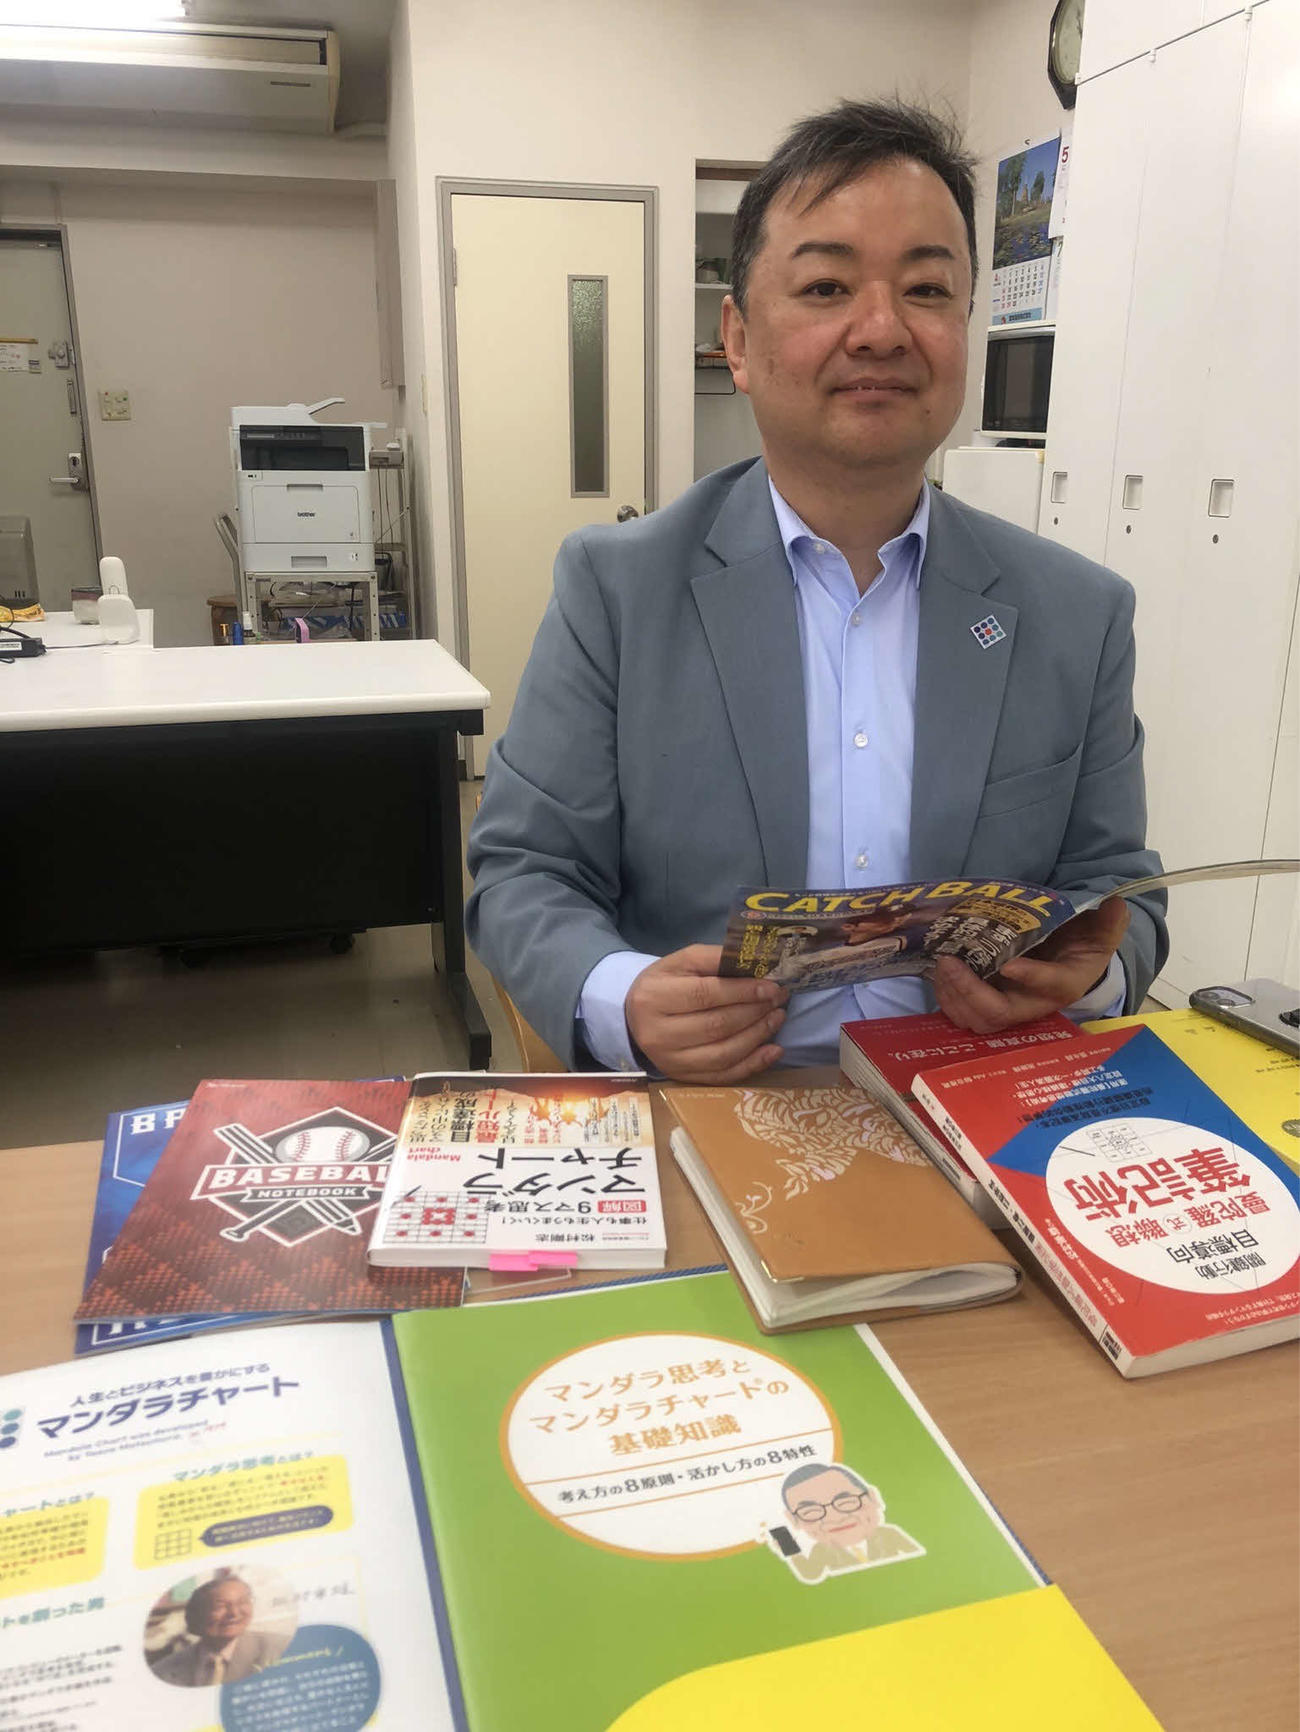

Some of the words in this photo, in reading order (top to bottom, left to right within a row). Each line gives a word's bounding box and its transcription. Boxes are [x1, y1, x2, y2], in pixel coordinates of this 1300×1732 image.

[745, 887, 924, 912] CATCH
[925, 881, 1051, 918] BALL
[406, 1153, 461, 1162] Mandala
[477, 1148, 642, 1170] チャート
[257, 1186, 358, 1199] NOTEBOOK
[462, 1172, 646, 1197] マンダラ
[1063, 1147, 1250, 1222] 筆記術
[502, 1217, 648, 1225] 仕事も人生もうまくいく!
[1167, 1227, 1259, 1264] 目標導向
[1197, 1250, 1266, 1281] 關鍵行動
[70, 1362, 270, 1407] 人生とビジネスを豊かにする
[544, 1359, 753, 1402] マンダラ思考と
[37, 1378, 299, 1439] マンダラチャート
[610, 1415, 742, 1456] 基礎知識
